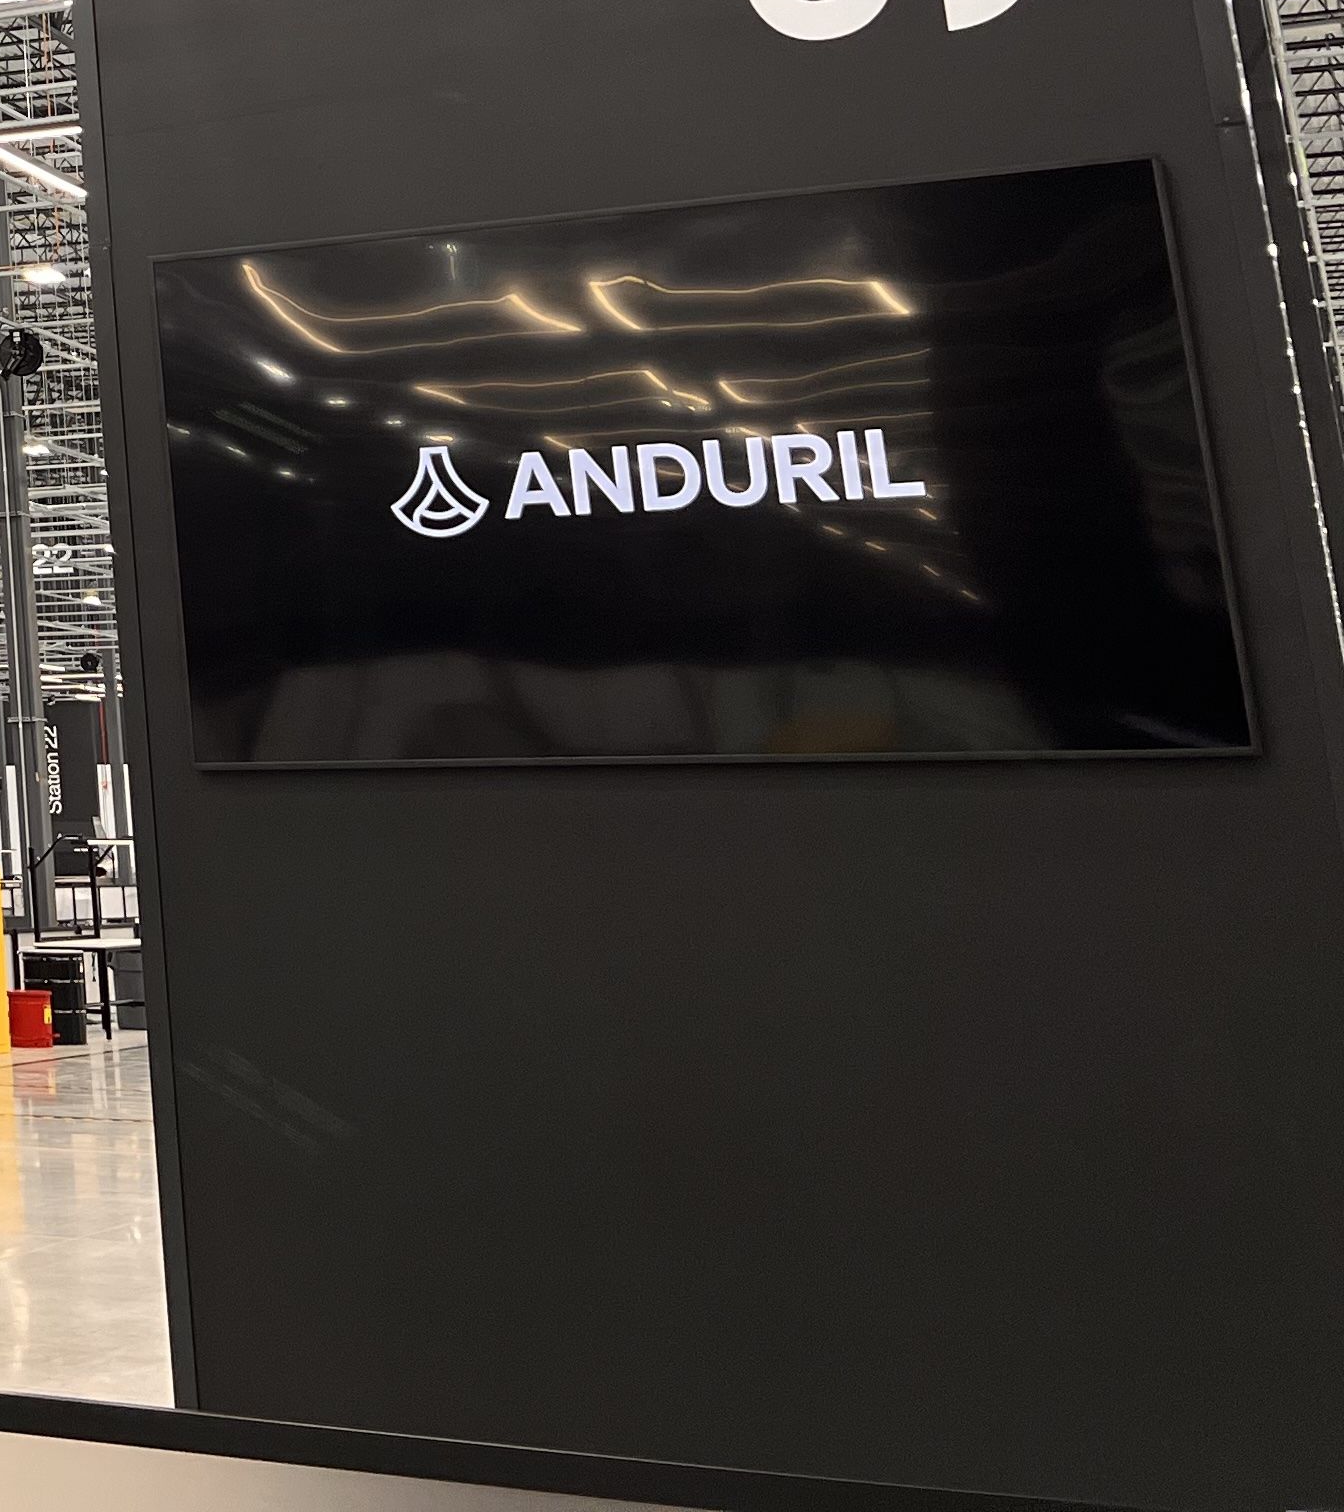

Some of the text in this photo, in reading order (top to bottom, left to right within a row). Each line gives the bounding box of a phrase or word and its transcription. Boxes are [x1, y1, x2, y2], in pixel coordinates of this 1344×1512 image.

[505, 424, 926, 519] ANDURIL
[32, 543, 74, 575] 22
[44, 725, 63, 815] Station 22
